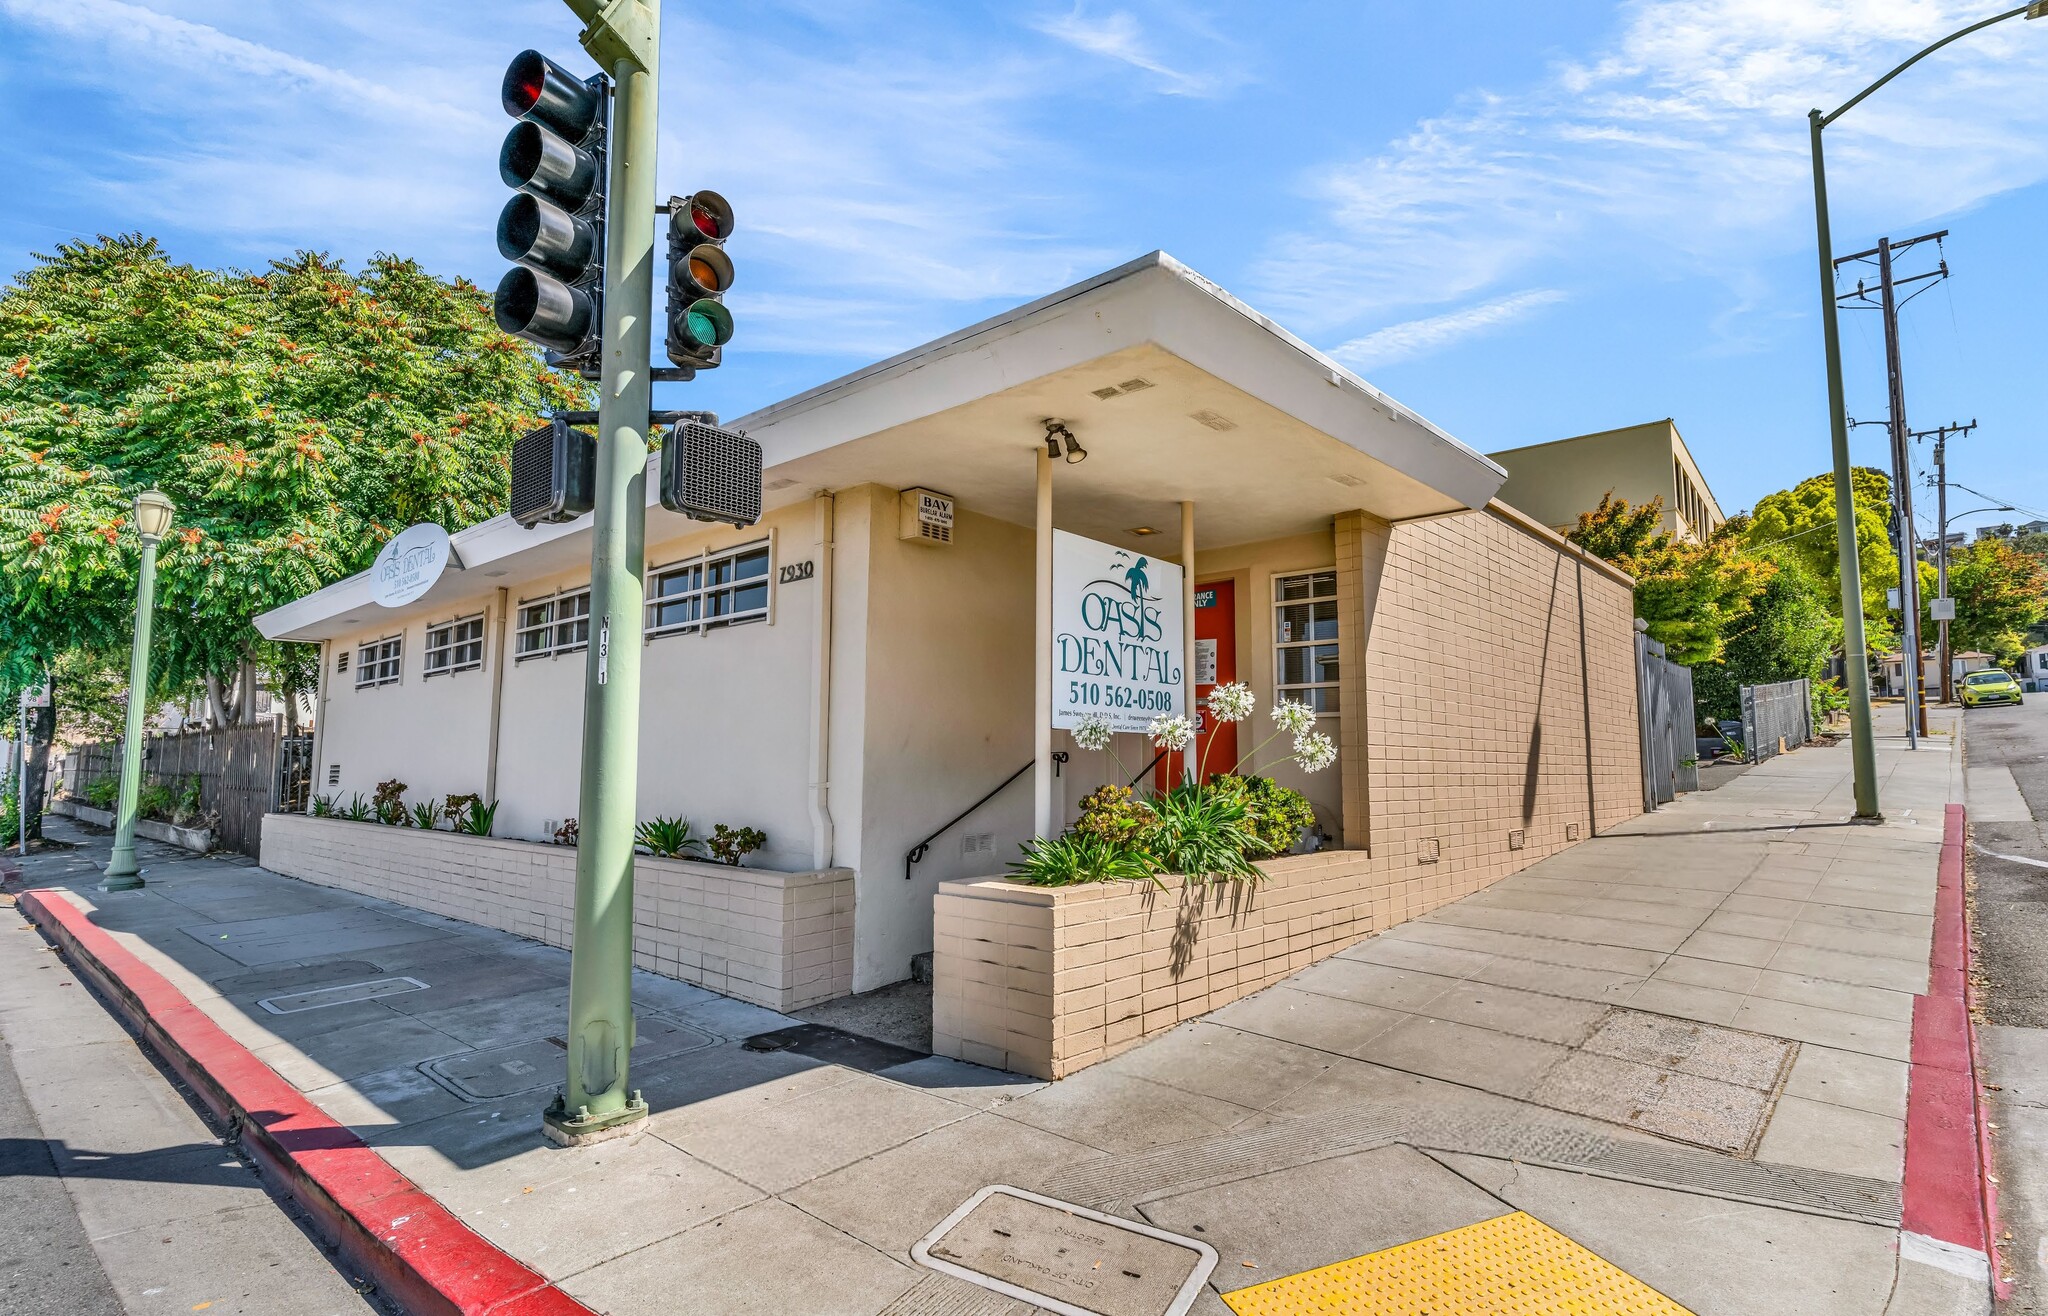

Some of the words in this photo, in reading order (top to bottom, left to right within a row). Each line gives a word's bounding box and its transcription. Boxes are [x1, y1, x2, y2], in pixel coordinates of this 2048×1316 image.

[924, 496, 950, 511] BAY
[939, 511, 953, 520] ALARM
[380, 560, 401, 582] OASIS
[402, 546, 436, 574] DENTAL
[779, 560, 814, 584] 7930
[1194, 599, 1208, 608] NLY
[1081, 592, 1163, 643] OASIS
[1057, 633, 1181, 685] DENTAL
[1069, 681, 1100, 705] 510
[1104, 685, 1172, 711] 562-0508
[1054, 1226, 1106, 1246] ELECTRIC
[1001, 1254, 1051, 1274] OAKLAND
[1052, 1272, 1068, 1280] OF
[1071, 1277, 1095, 1289] CITY
